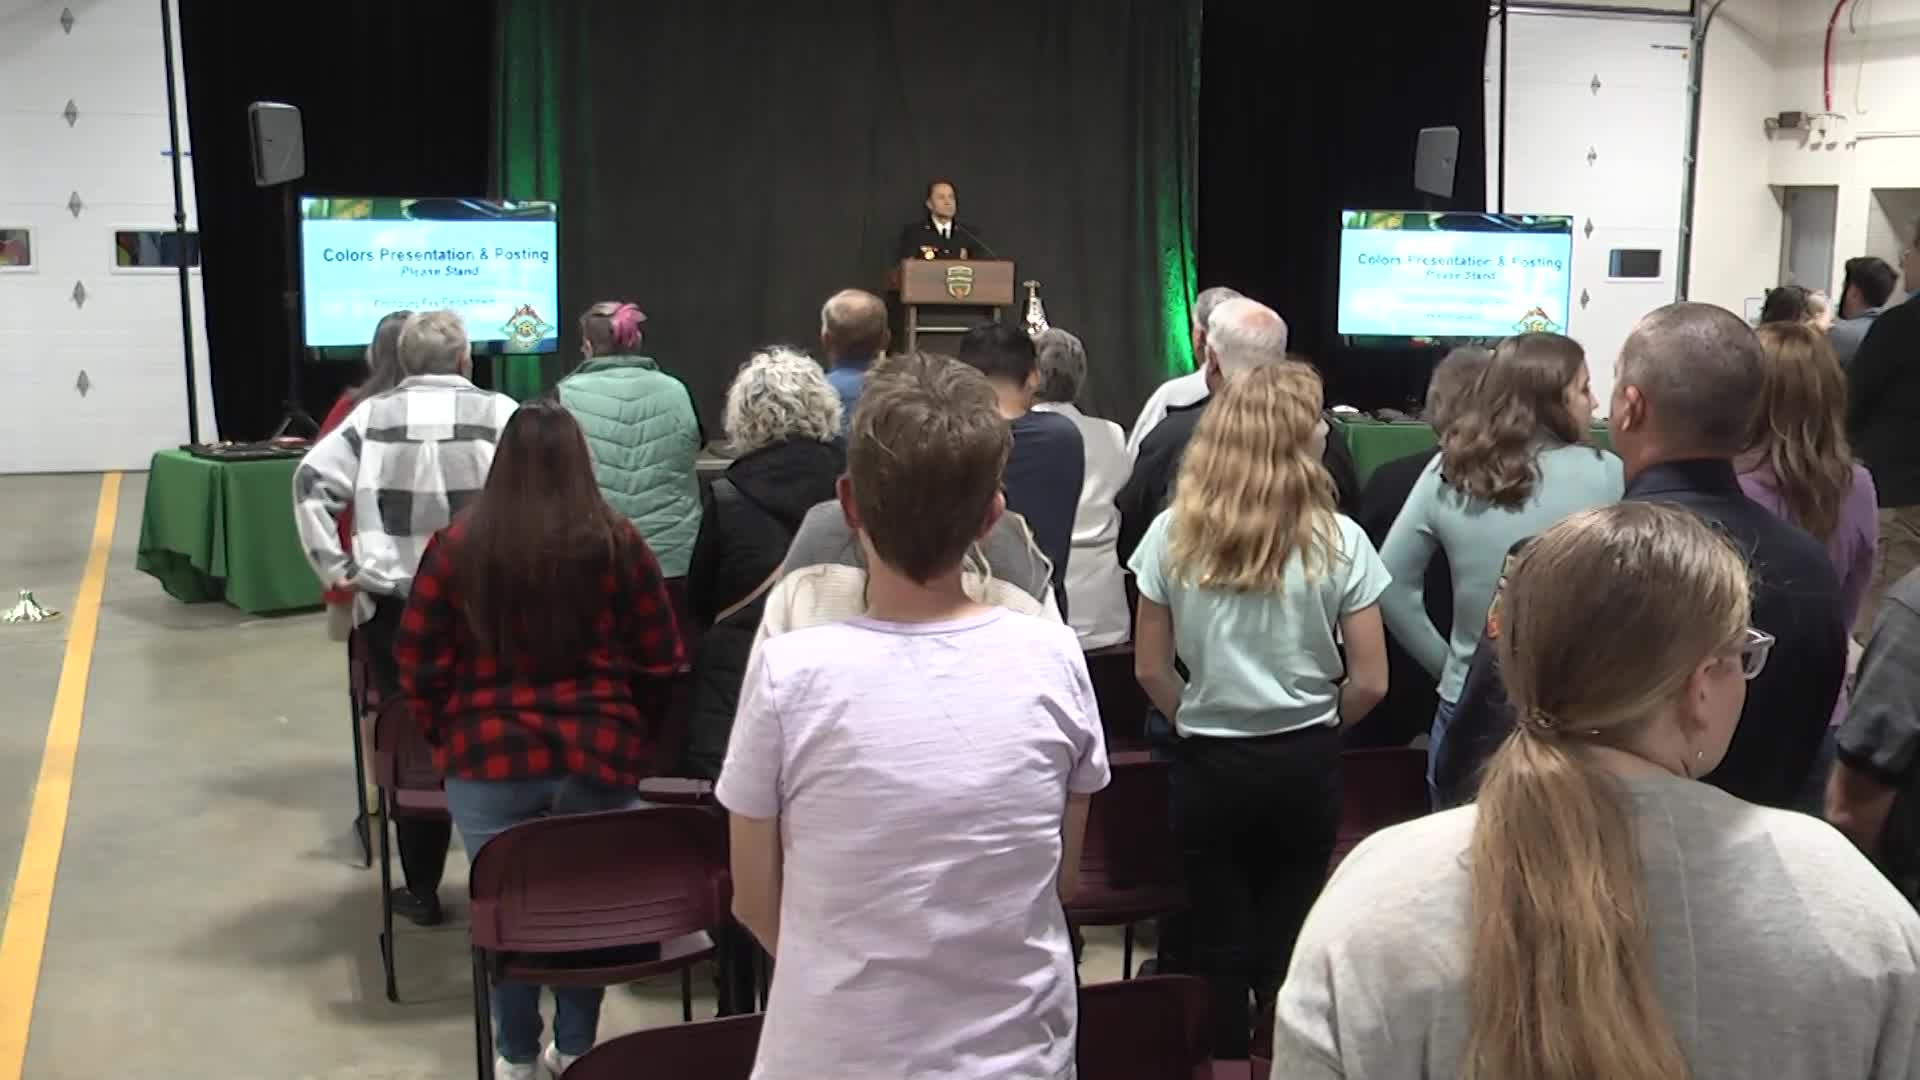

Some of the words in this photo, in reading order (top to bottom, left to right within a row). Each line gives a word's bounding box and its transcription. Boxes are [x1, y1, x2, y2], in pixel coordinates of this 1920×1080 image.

[323, 248, 374, 262] Colors
[380, 248, 475, 262] Presentation
[480, 248, 489, 261] &
[495, 248, 549, 264] Posting
[445, 266, 480, 277] Stand
